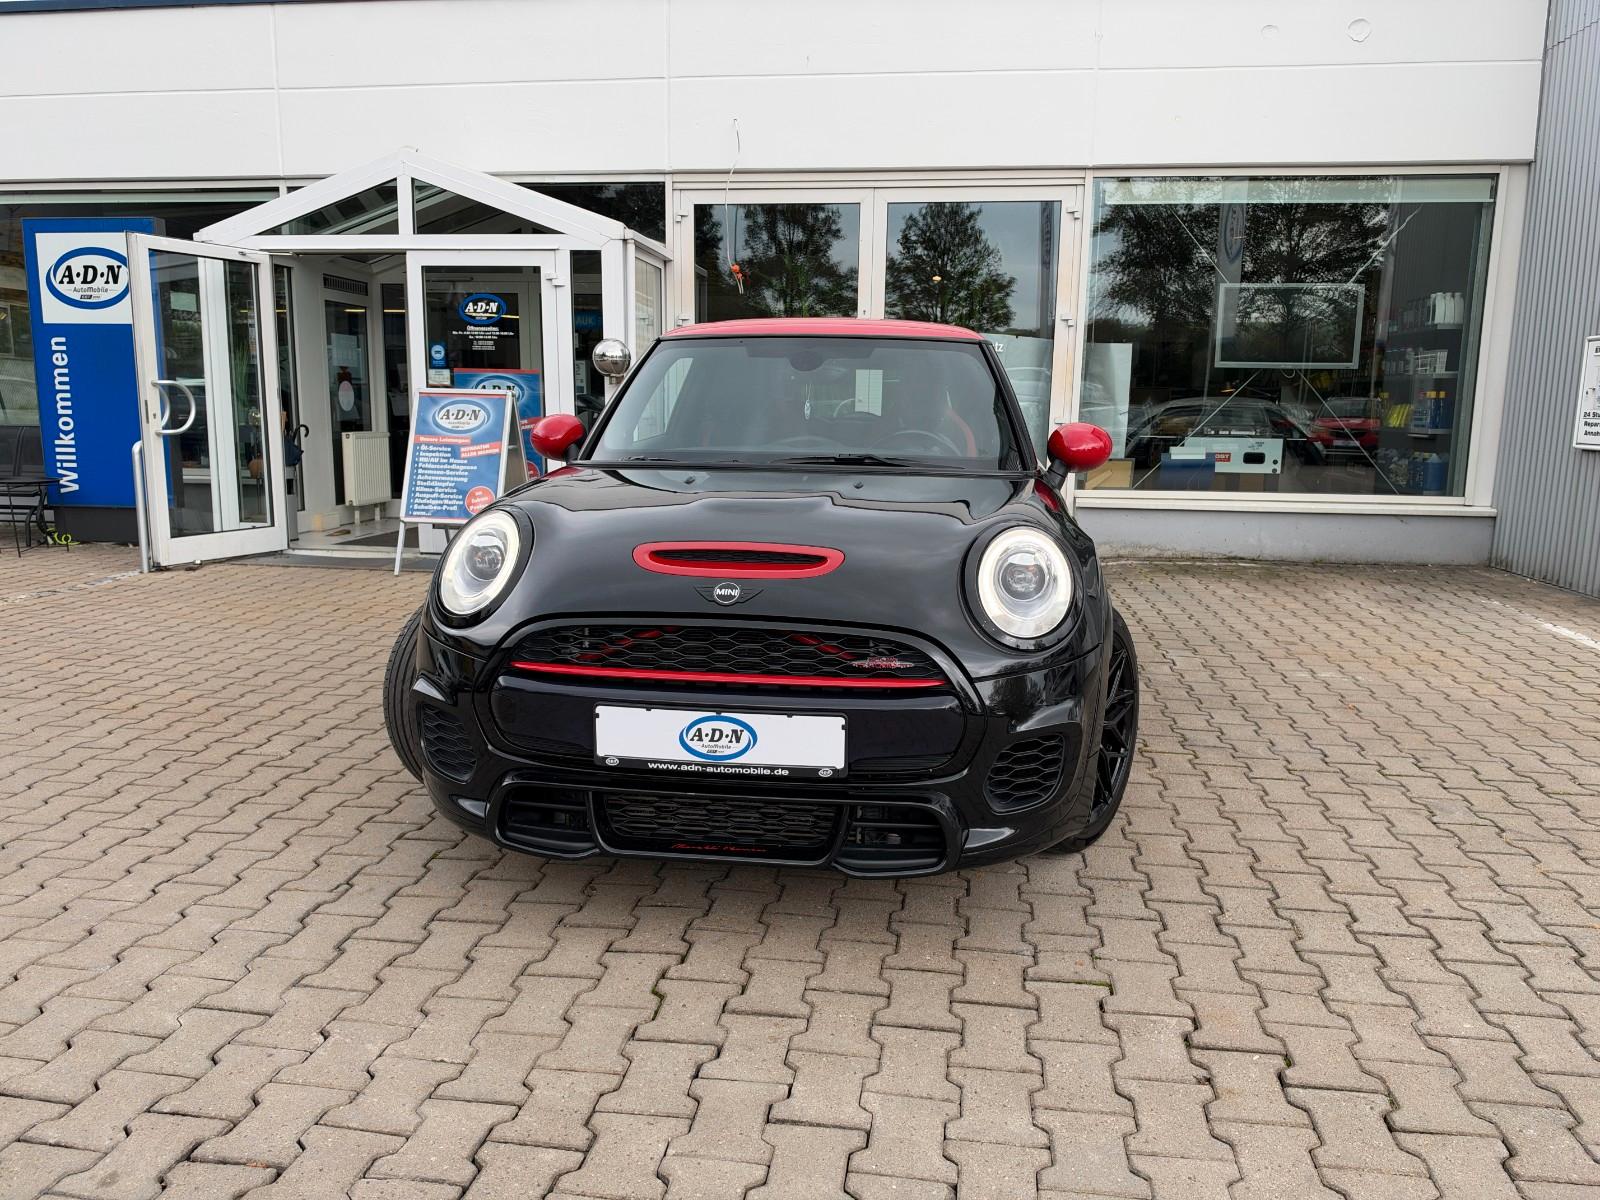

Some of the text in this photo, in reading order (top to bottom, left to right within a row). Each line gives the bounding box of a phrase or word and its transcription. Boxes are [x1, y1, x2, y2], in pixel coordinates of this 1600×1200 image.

[993, 342, 1004, 352] tz
[51, 336, 80, 493] Willkommen
[716, 588, 739, 596] MINI
[648, 762, 789, 776] www.adn-automobile.de
